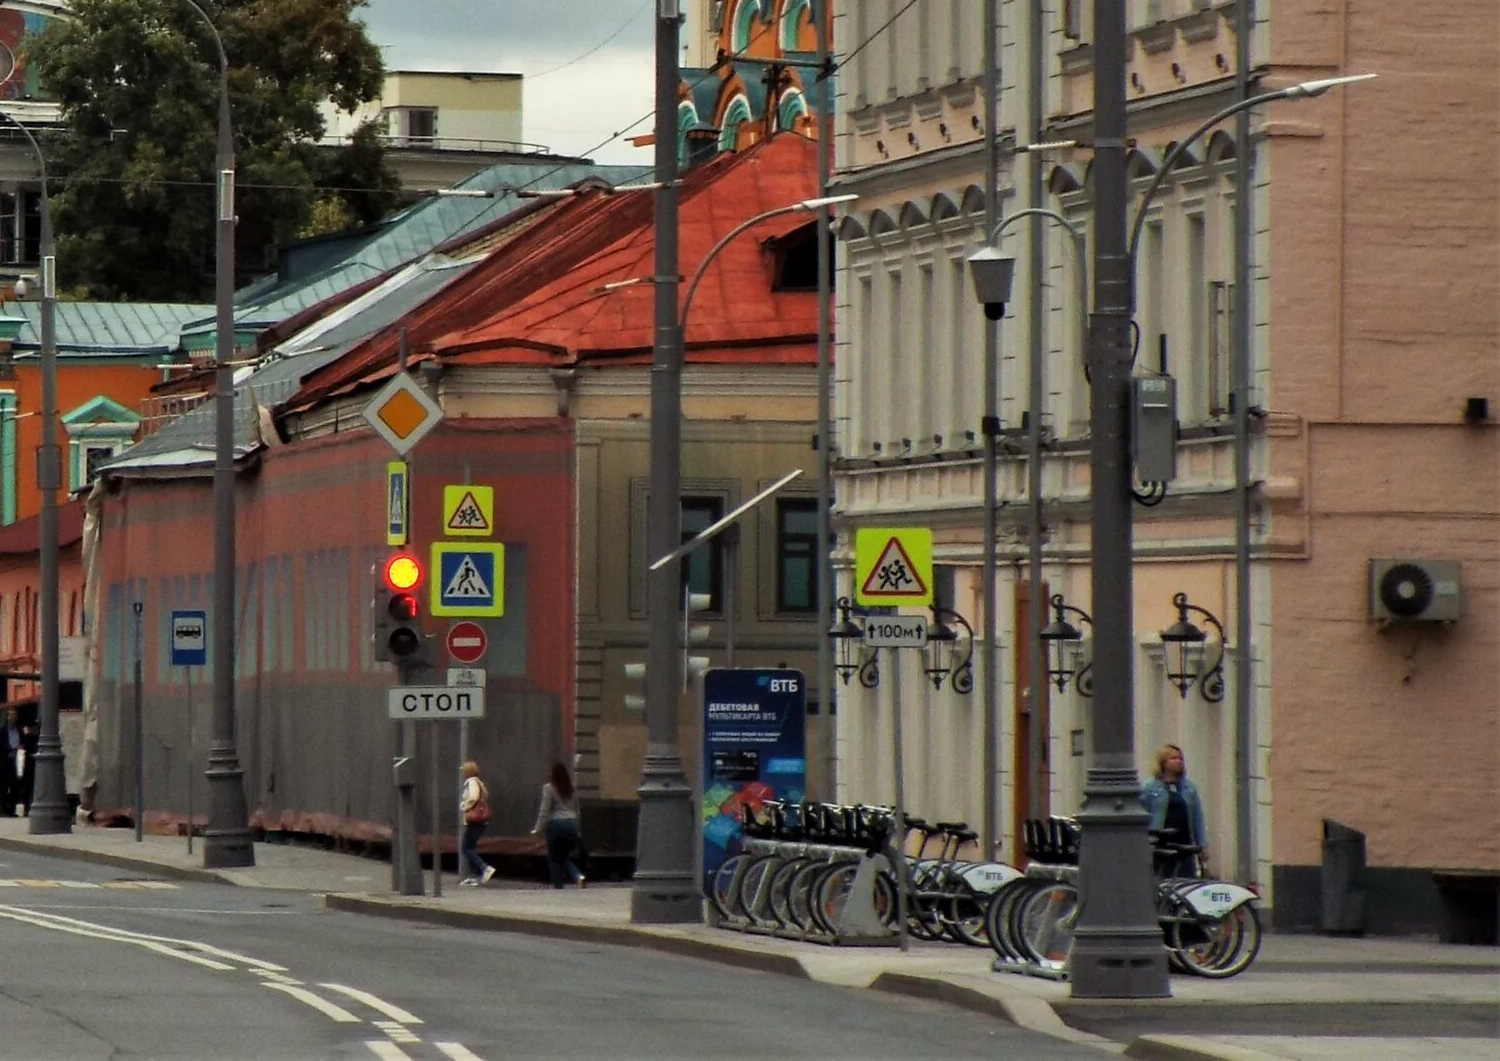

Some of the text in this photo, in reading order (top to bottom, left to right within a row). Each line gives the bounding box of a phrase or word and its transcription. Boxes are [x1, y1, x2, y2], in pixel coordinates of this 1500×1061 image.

[770, 679, 798, 692] ВТБ
[402, 694, 471, 712] СТОП
[708, 703, 760, 712] ДЕБЕТОВАЯ
[985, 871, 1003, 881] ВТБ
[1211, 892, 1232, 903] ВТБ
